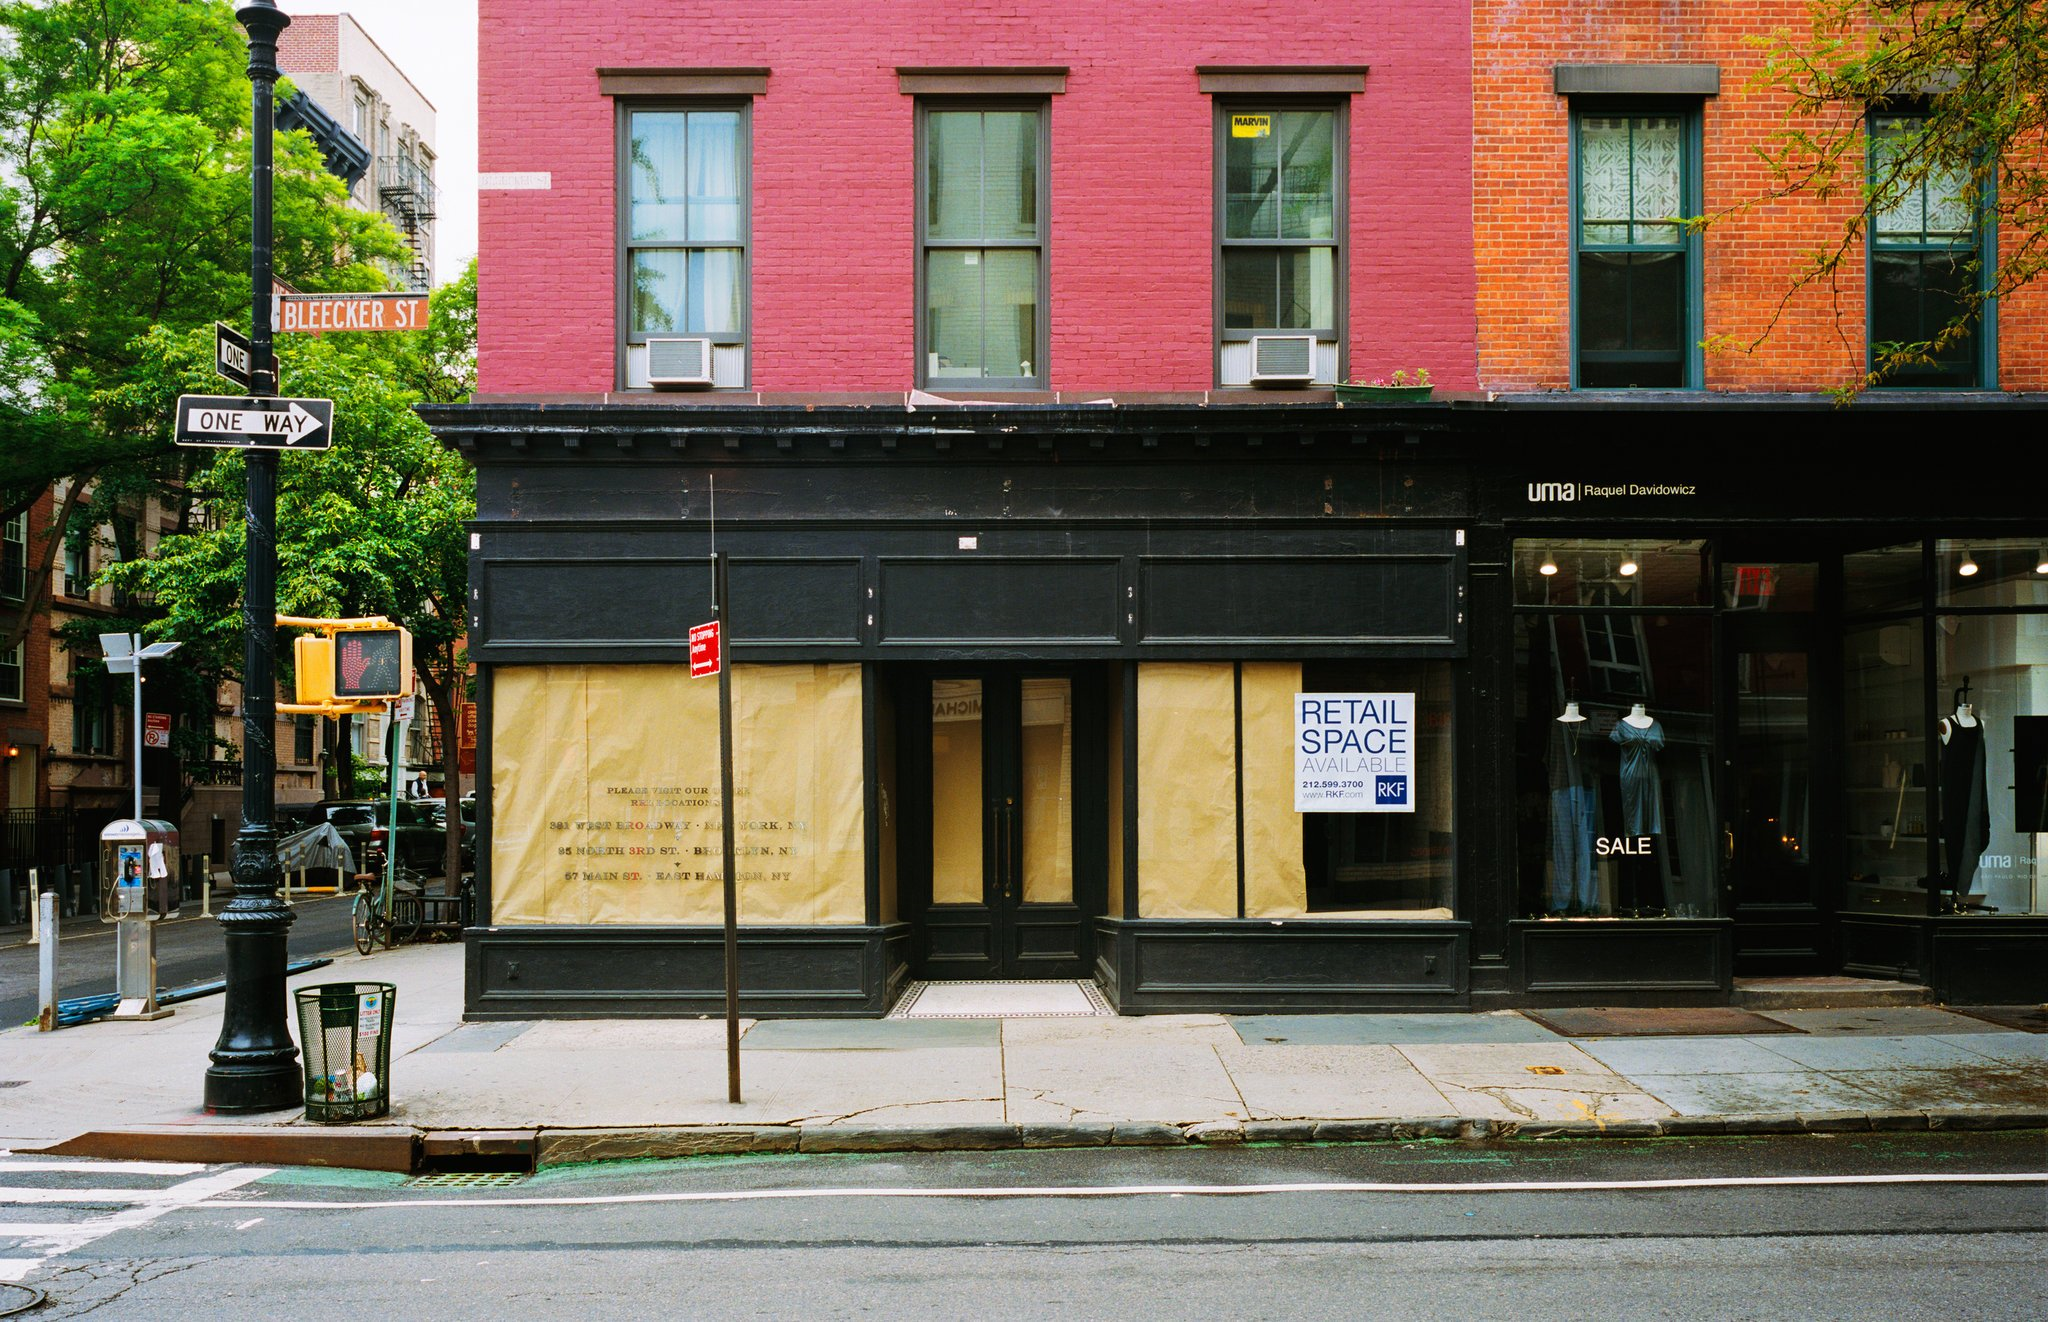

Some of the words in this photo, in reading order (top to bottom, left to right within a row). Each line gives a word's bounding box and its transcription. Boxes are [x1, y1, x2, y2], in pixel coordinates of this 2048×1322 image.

[1234, 117, 1268, 126] MARVIN
[285, 300, 385, 329] BLEECKER
[394, 299, 419, 328] ST
[226, 344, 245, 371] ONE
[200, 411, 243, 431] ONE
[264, 413, 308, 433] WAY
[1528, 482, 1575, 502] uma
[1584, 484, 1626, 498] Raquel
[1629, 483, 1696, 496] Davidowicz
[1302, 700, 1407, 724] RETAIL
[1302, 729, 1406, 754] SPACE
[1301, 757, 1407, 773] AVAILABLE
[1302, 780, 1364, 788] 212.599.3700
[1377, 782, 1405, 798] RKF
[1302, 790, 1364, 799] www.RKF.com
[549, 821, 570, 830] 381
[576, 821, 612, 830] WEST
[615, 821, 692, 830] BROADWAY
[576, 846, 625, 856] NORTH
[629, 846, 656, 856] 3RD
[660, 846, 680, 856] ST.
[694, 846, 774, 856] BROKLYN,
[1595, 836, 1652, 856] SALE
[1979, 855, 2012, 869] uma
[582, 872, 619, 881] MAIN
[622, 872, 643, 881] ST.
[656, 872, 691, 881] EAST
[695, 872, 768, 881] HAMTON,
[771, 872, 792, 881] NY
